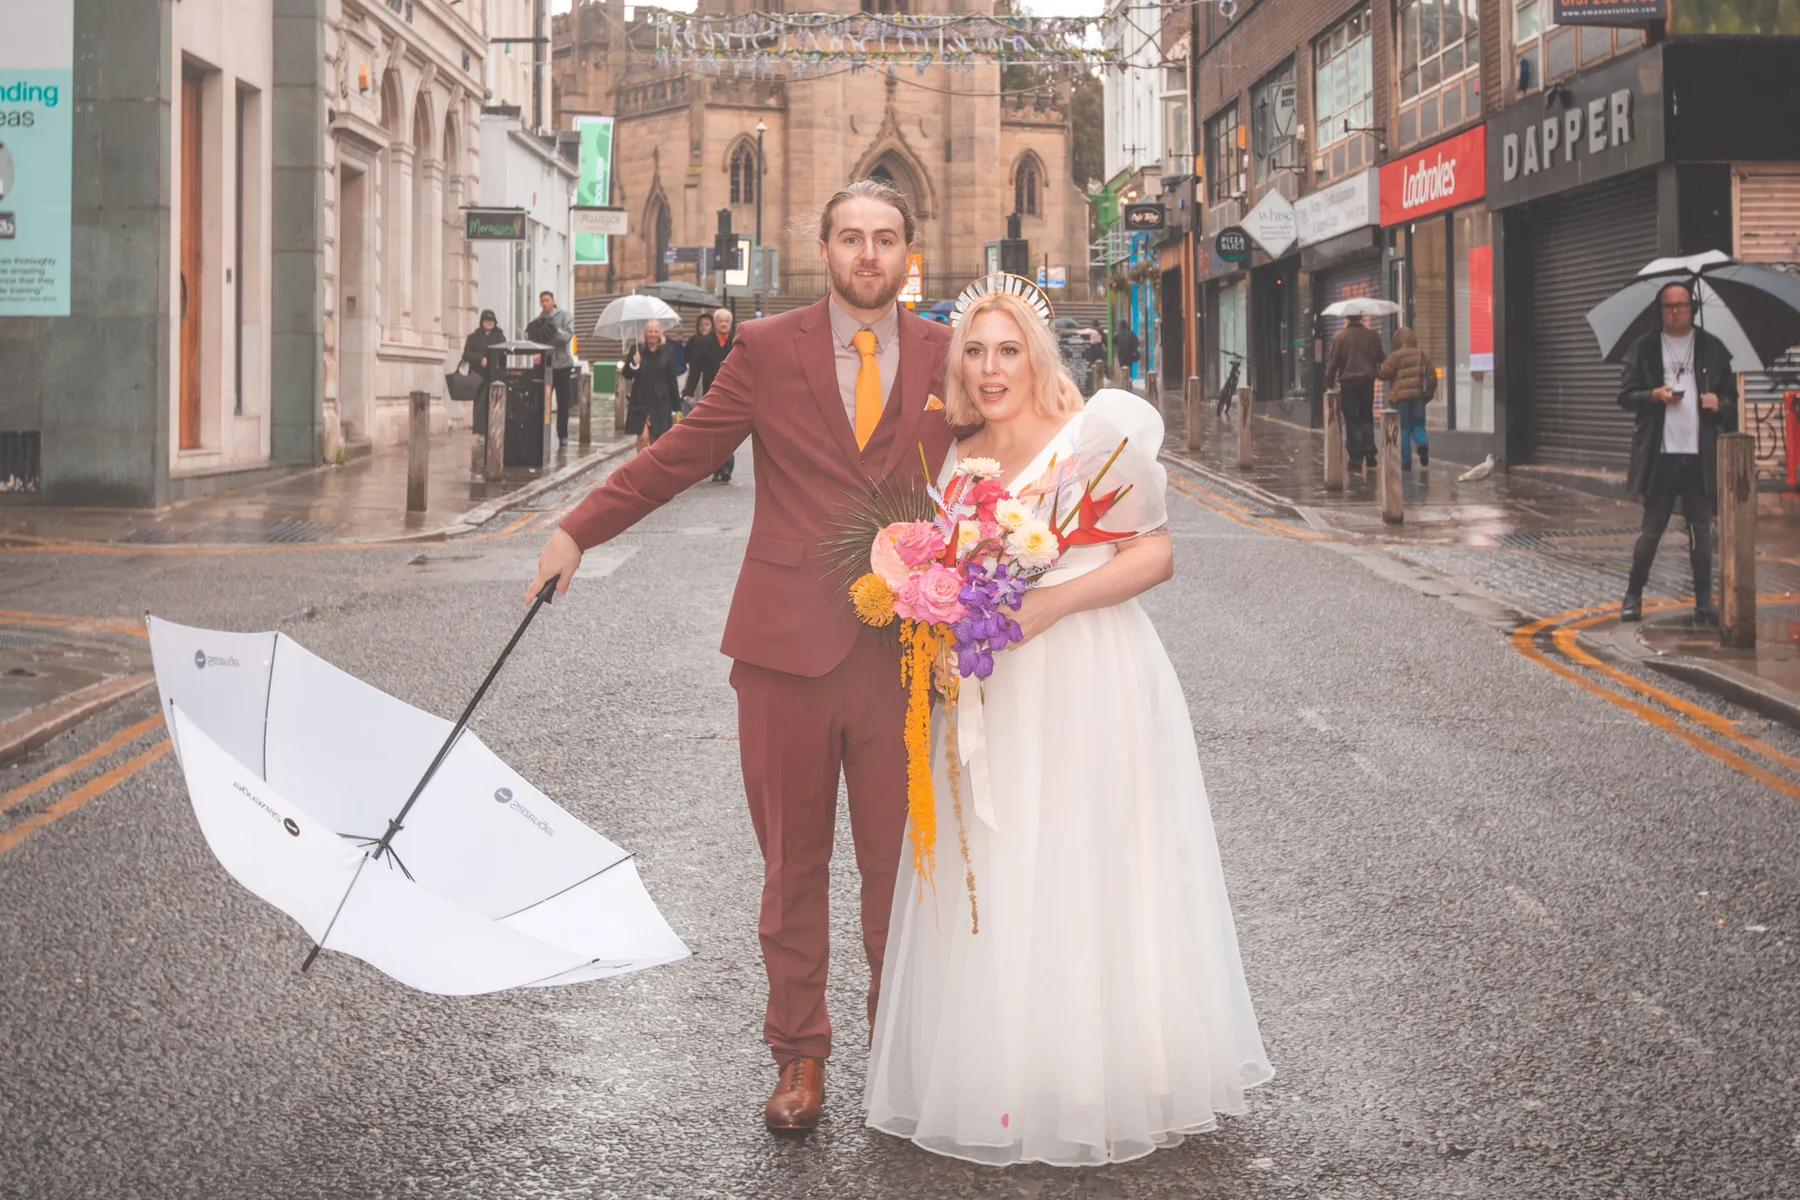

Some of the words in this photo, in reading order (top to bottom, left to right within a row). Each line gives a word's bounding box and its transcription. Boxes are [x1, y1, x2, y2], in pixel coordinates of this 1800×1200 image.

[1503, 88, 1633, 183] DAPPER
[1402, 152, 1457, 209] Ladbrokes
[580, 214, 621, 226] Rudy's
[1221, 235, 1245, 244] PIZZA
[232, 780, 282, 823] Slazenger
